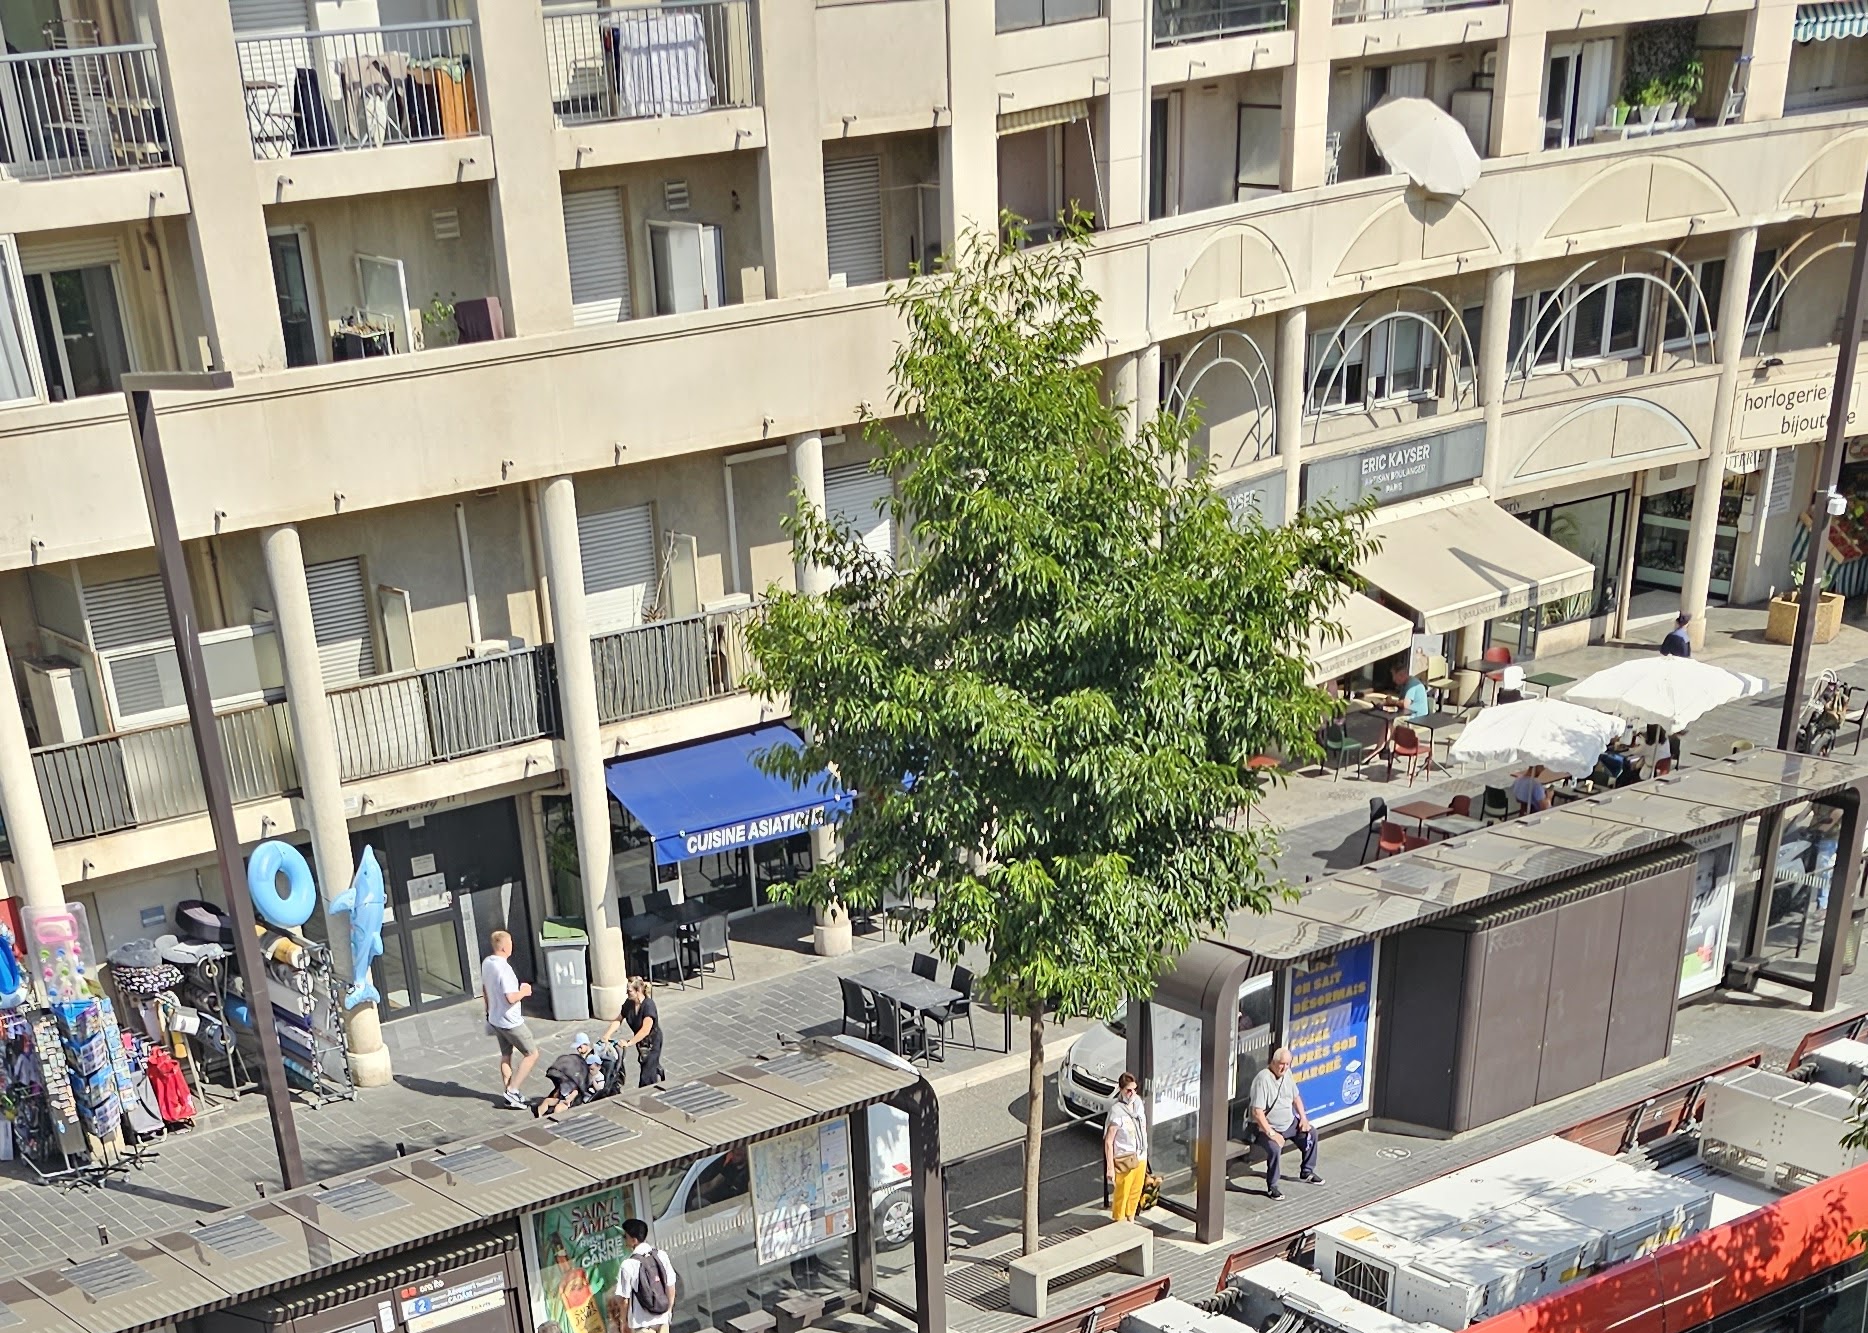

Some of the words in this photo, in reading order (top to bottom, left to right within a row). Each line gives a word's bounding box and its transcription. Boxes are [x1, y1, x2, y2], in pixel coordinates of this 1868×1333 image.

[1743, 384, 1827, 412] horlogerie
[1780, 411, 1857, 438] bijoute
[1361, 453, 1387, 475] ERIC
[1388, 443, 1431, 468] KAYSER
[1226, 489, 1256, 512] AYSER
[686, 824, 747, 854] CUISINE
[571, 1196, 619, 1221] SAINT
[569, 1211, 621, 1242] JAMES
[581, 1247, 625, 1268] CANNE
[589, 1234, 624, 1255] PURE
